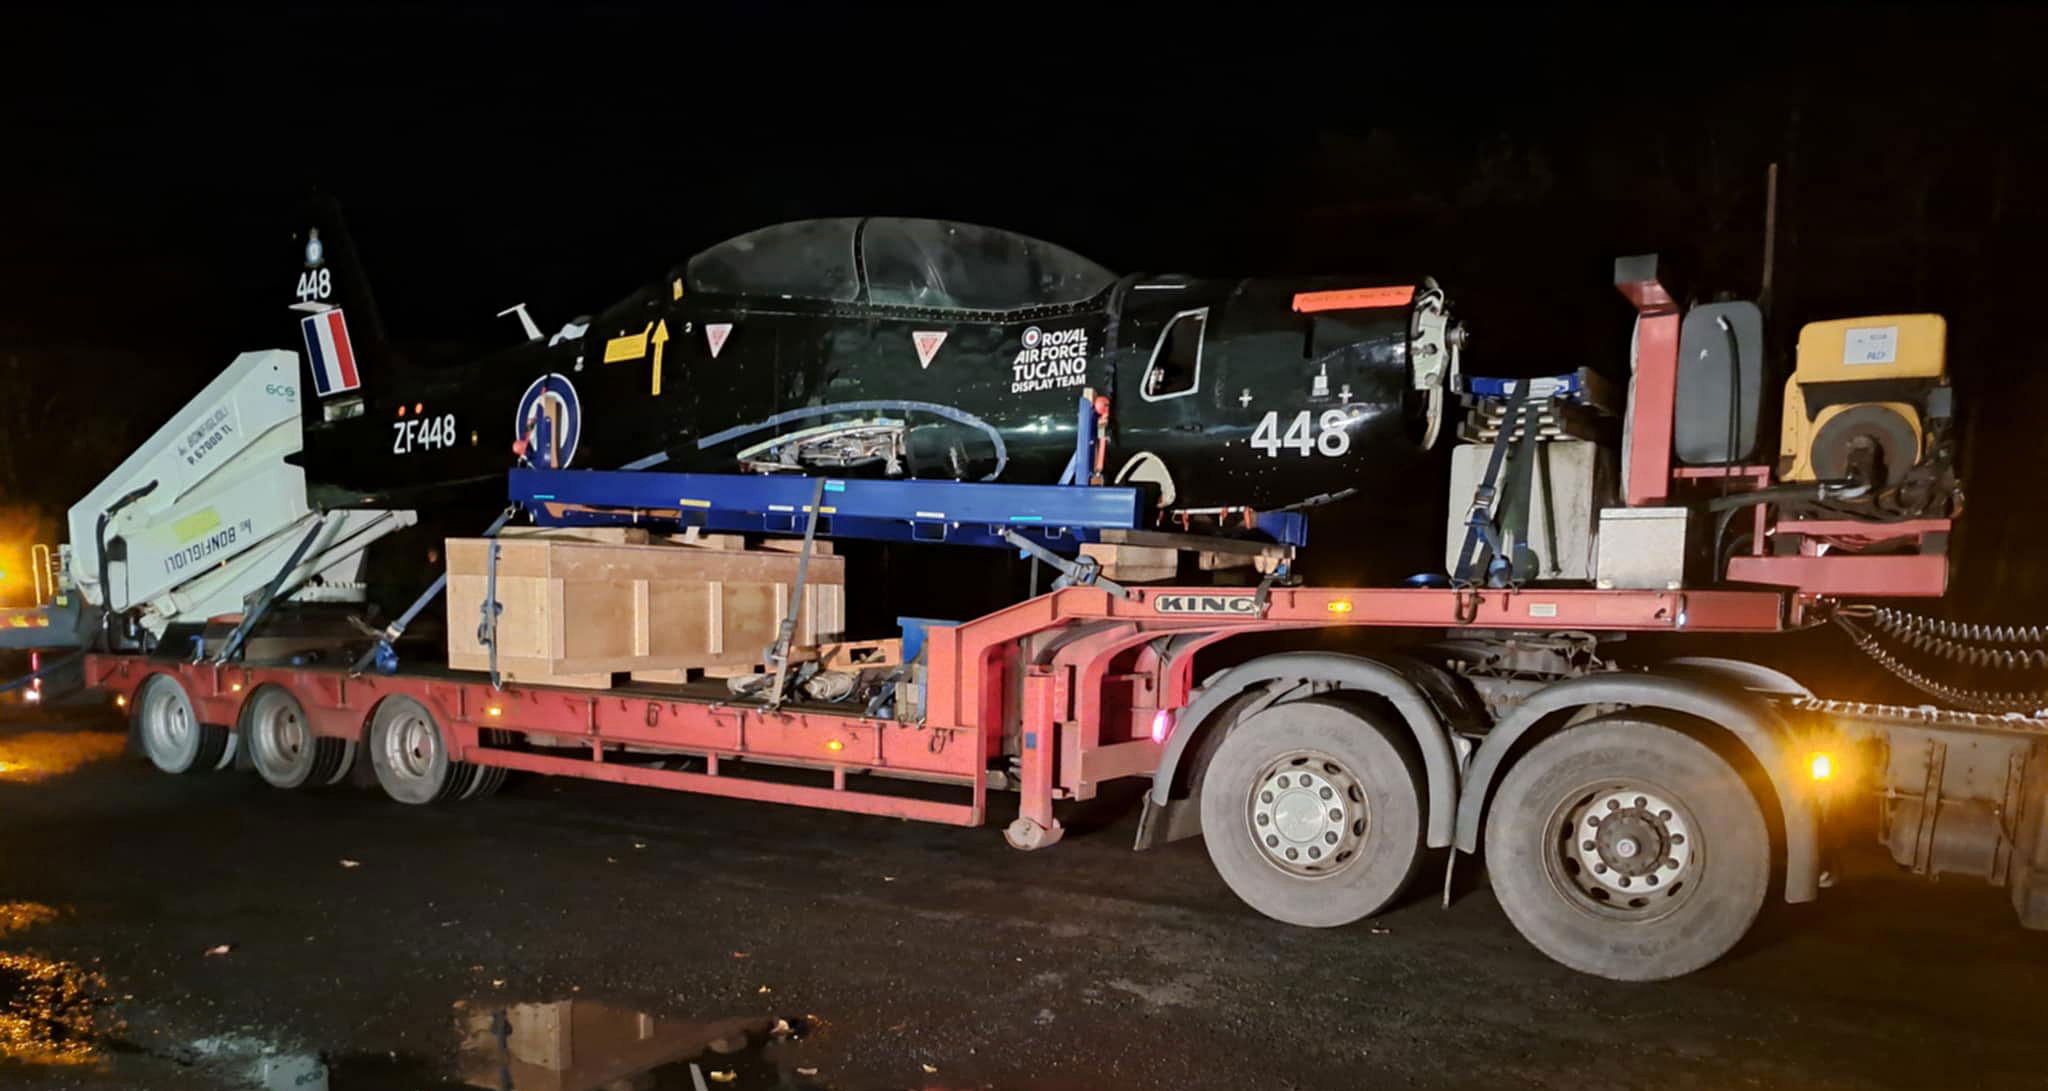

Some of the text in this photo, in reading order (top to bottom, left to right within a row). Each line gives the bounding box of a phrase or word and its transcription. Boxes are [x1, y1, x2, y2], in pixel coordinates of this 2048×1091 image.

[297, 268, 331, 302] 448
[1042, 328, 1088, 346] ROYAL
[1013, 342, 1088, 365] AIR FORCE
[1012, 357, 1086, 382] TUCANO
[1011, 374, 1086, 393] DISPLAY TEAM
[393, 413, 456, 454] ZF448
[1250, 409, 1350, 457] 448
[163, 526, 236, 574] BONFIGLIOLI
[1161, 597, 1257, 612] KING
